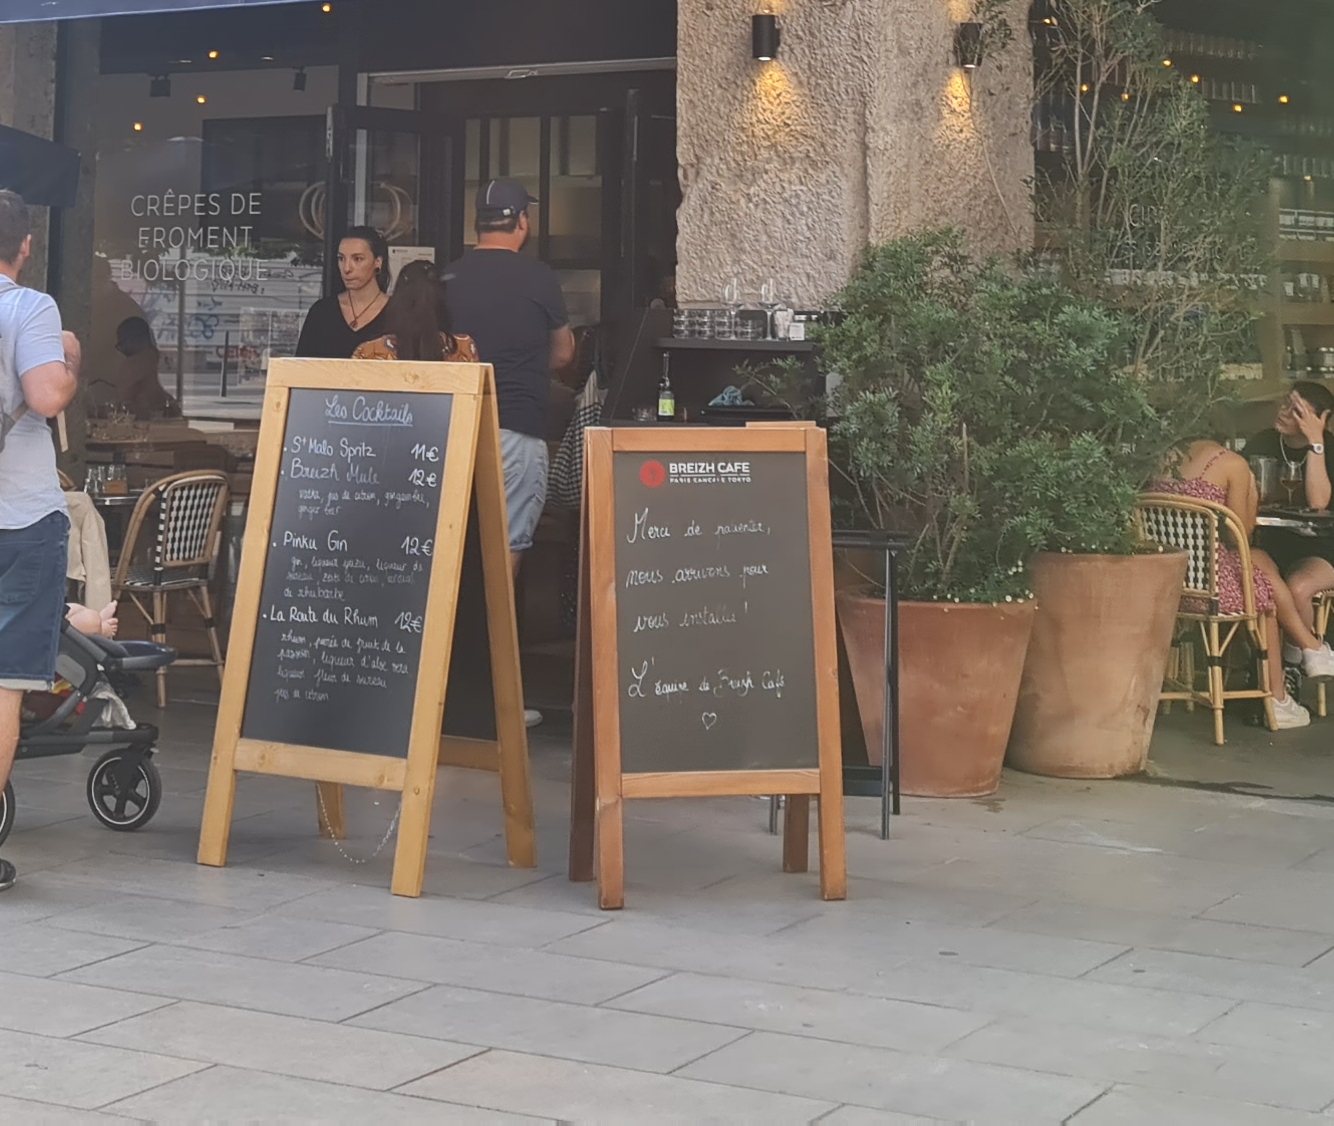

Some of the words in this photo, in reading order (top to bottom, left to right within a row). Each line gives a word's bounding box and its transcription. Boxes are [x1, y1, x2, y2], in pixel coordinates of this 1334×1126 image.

[130, 188, 221, 217] CRÊPES
[230, 192, 263, 215] DE
[120, 259, 269, 284] BIOLOGIQUE
[325, 394, 348, 419] Les
[352, 395, 413, 425] Cocktails
[308, 439, 334, 458] Malo
[340, 437, 376, 463] Spritz
[410, 443, 440, 463] 11€
[346, 463, 380, 485] Mule
[408, 468, 437, 488] 12€
[669, 462, 715, 474] BREIZH
[717, 462, 751, 474] CAFE
[626, 506, 671, 544] Merci
[684, 520, 702, 538] de
[327, 529, 348, 552] Gin
[400, 535, 434, 557] 12€
[625, 568, 664, 589] nous
[270, 605, 286, 623] La
[322, 607, 339, 625] du
[344, 606, 379, 629] Rhum
[633, 611, 670, 633] vous
